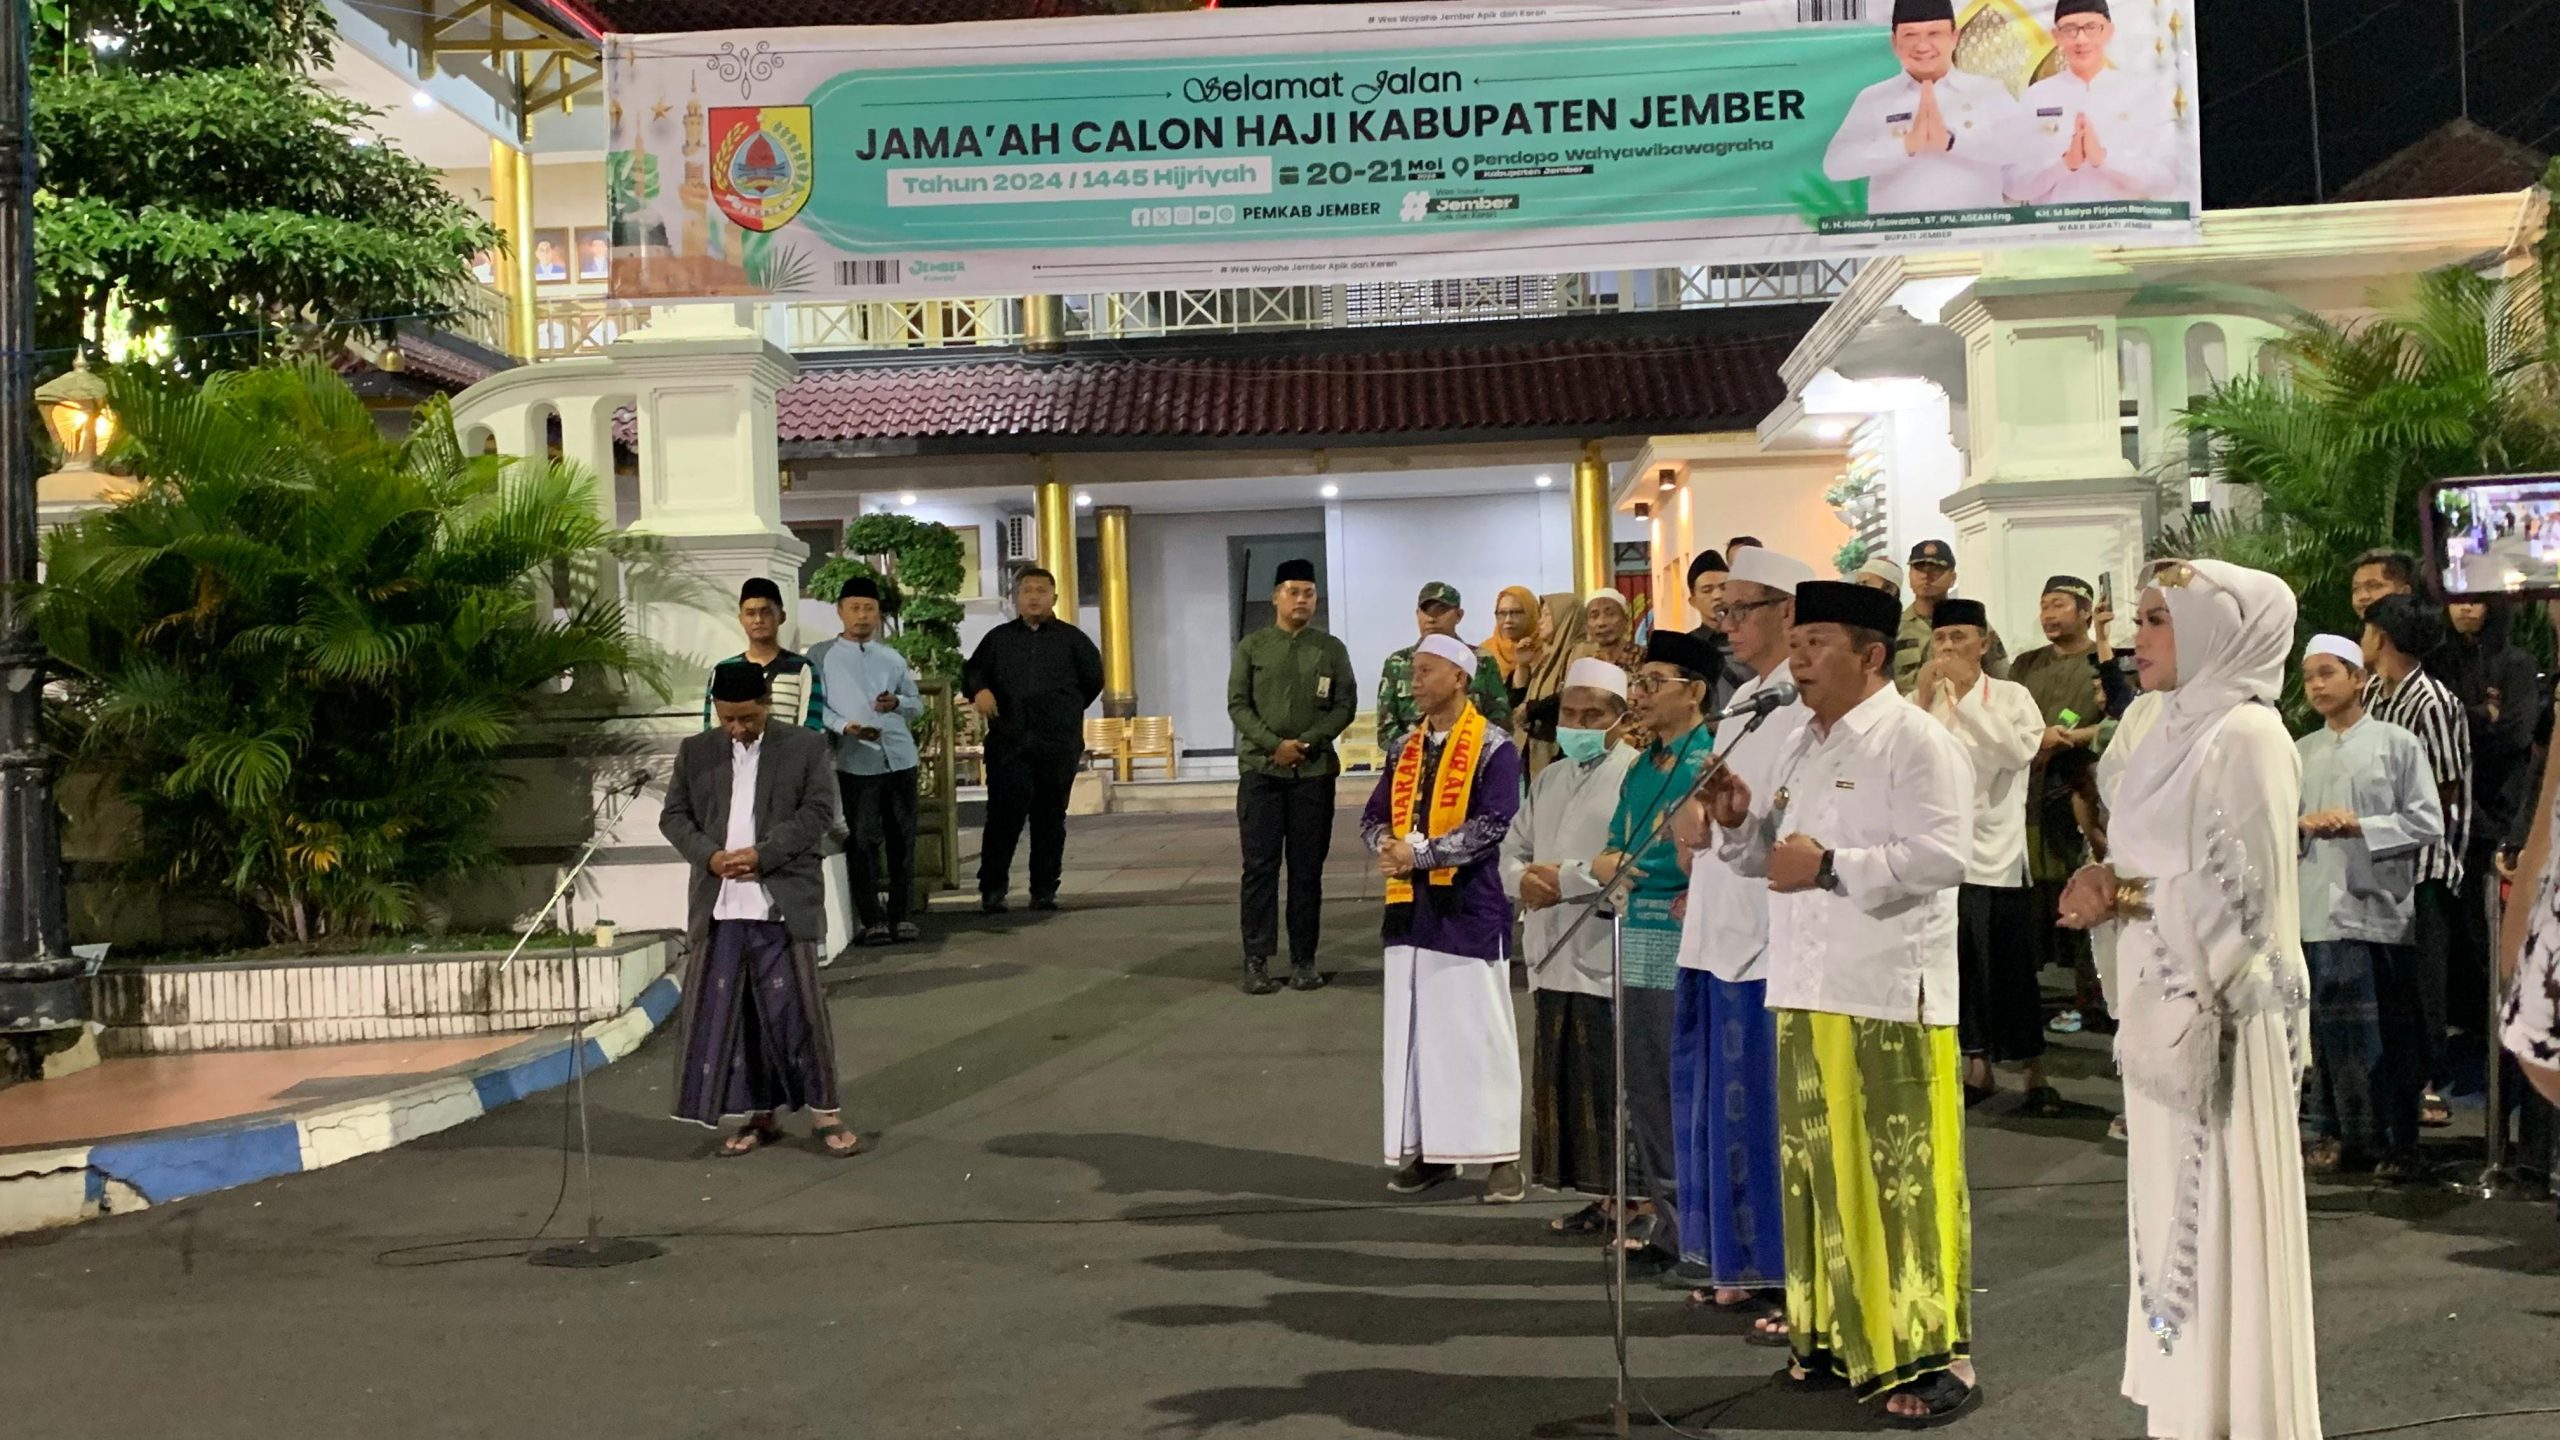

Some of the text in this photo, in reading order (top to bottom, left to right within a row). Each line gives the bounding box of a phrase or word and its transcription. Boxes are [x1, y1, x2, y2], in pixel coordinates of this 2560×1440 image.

[1400, 14, 1438, 25] Wayahe
[1440, 12, 1475, 22] Jember
[1477, 11, 1497, 21] Apik
[1500, 10, 1518, 18] dan
[1519, 9, 1547, 18] Keren
[1183, 67, 1462, 104] Selamat Jalan
[1072, 116, 1223, 153] CALON
[1236, 112, 1336, 147] HAJI
[1349, 98, 1617, 143] KABUPATEN
[1629, 89, 1806, 129] JEMBER
[1473, 138, 1774, 167] Pendopo Wahyawibawagraha
[903, 163, 1257, 194] Tahun 2024 / 1445 Hijriyah
[1306, 156, 1443, 186] 20-21 Mei
[1483, 165, 1585, 179] Kabupaten Jember
[1243, 201, 1381, 220] PEMKAB JEMBER
[1436, 197, 1513, 212] Jember
[2089, 222, 2121, 230] BUPATI
[1884, 231, 1952, 241] BUPATI JEMBER
[908, 260, 966, 275] JEMBER
[1230, 265, 1250, 273] Wes
[1252, 264, 1289, 275] Wayahe
[1292, 263, 1326, 272] Jember
[1328, 261, 1348, 271] Apik
[1351, 260, 1368, 269] dan
[1370, 259, 1397, 268] Keren
